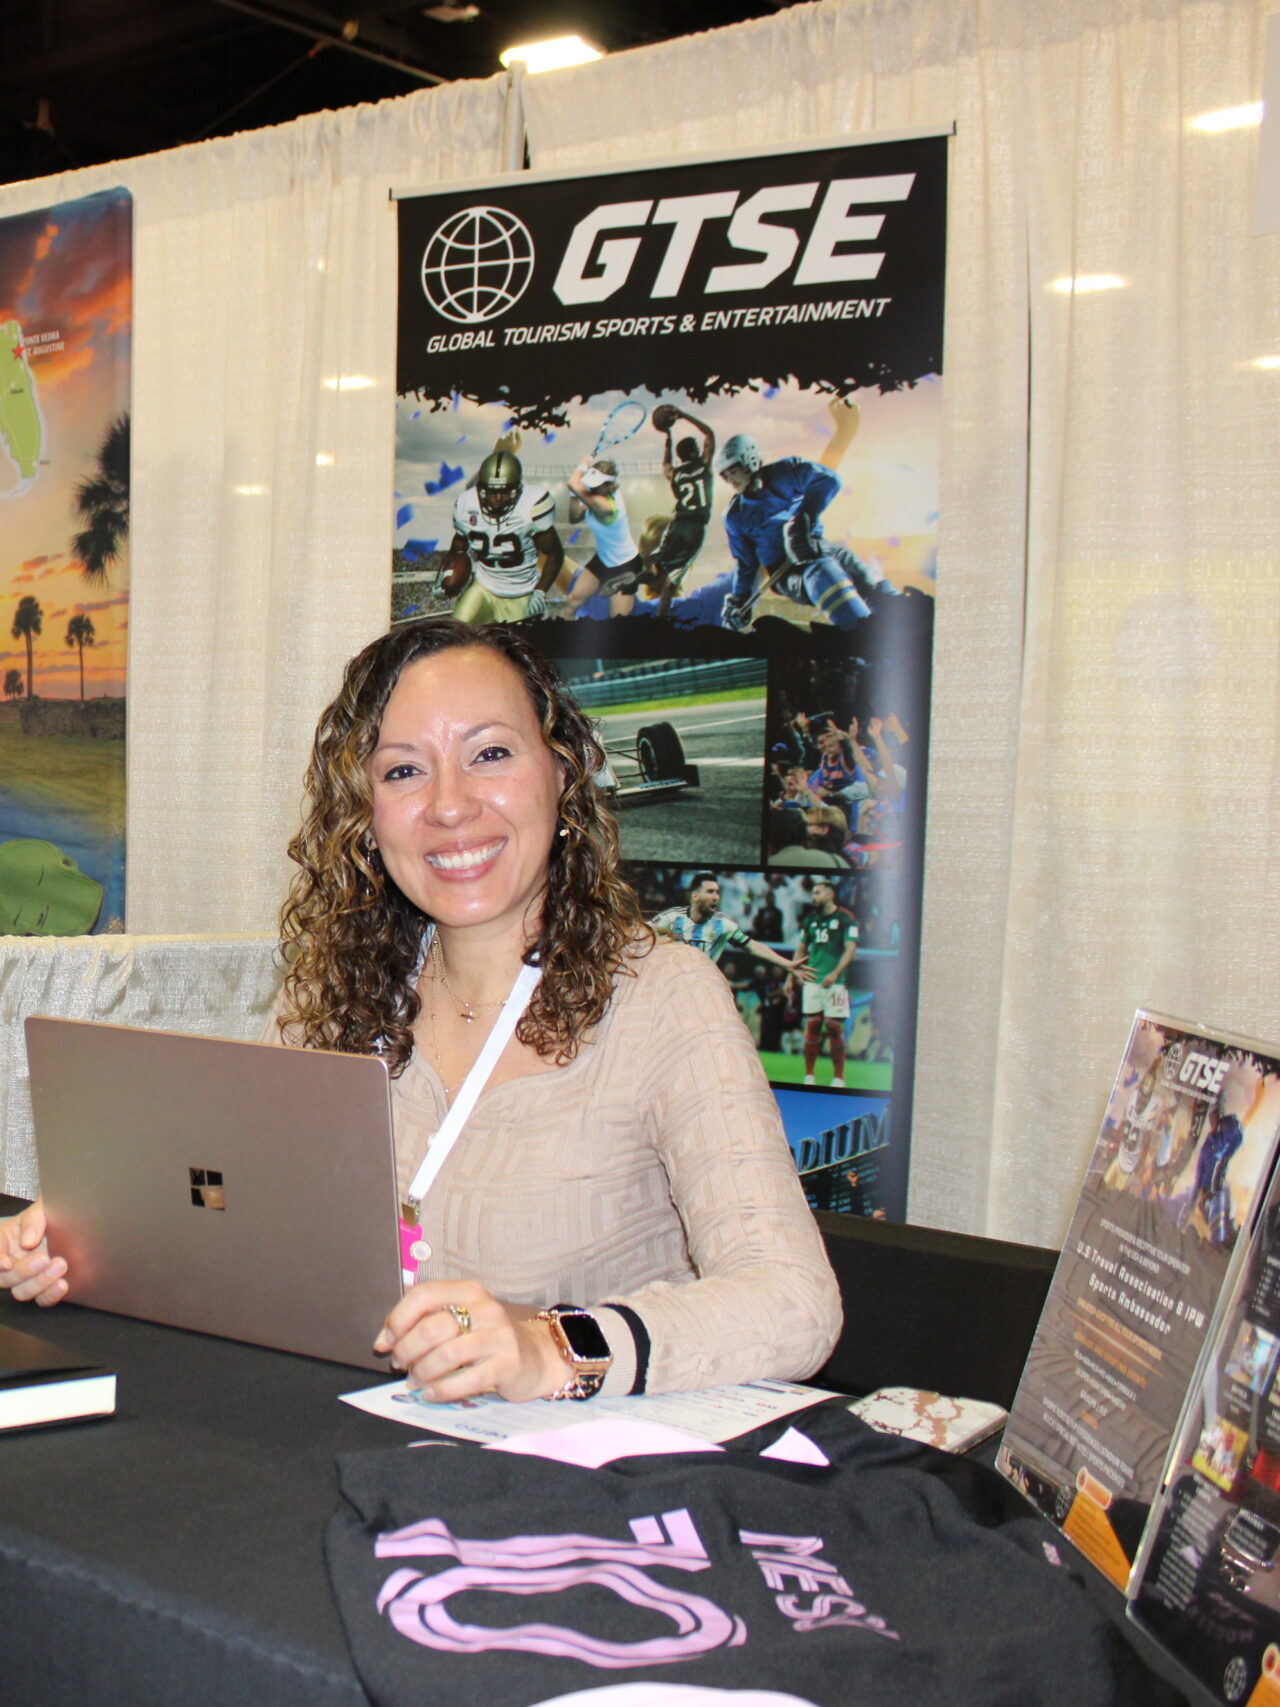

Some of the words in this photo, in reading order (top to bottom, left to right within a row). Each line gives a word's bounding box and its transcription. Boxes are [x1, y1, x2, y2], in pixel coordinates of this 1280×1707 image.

[552, 173, 916, 306] GTSE
[41, 330, 60, 342] VEDRA
[426, 329, 496, 354] GLOBAL
[503, 320, 590, 346] TOURISM
[592, 313, 676, 340] SPORTS
[679, 313, 695, 333] &
[700, 298, 892, 331] ENTERTAINMENT
[680, 479, 707, 511] 21
[815, 928, 829, 943] 16
[1179, 1051, 1230, 1094] GTSE
[788, 1100, 892, 1173] DIUM
[1076, 1240, 1091, 1259] U.S
[1091, 1249, 1118, 1275] Travel
[1176, 1300, 1184, 1316] &
[1184, 1305, 1205, 1329] IPW
[1089, 1272, 1117, 1301] Sports
[1118, 1291, 1171, 1335] Ambassador
[375, 1508, 747, 1668] 10
